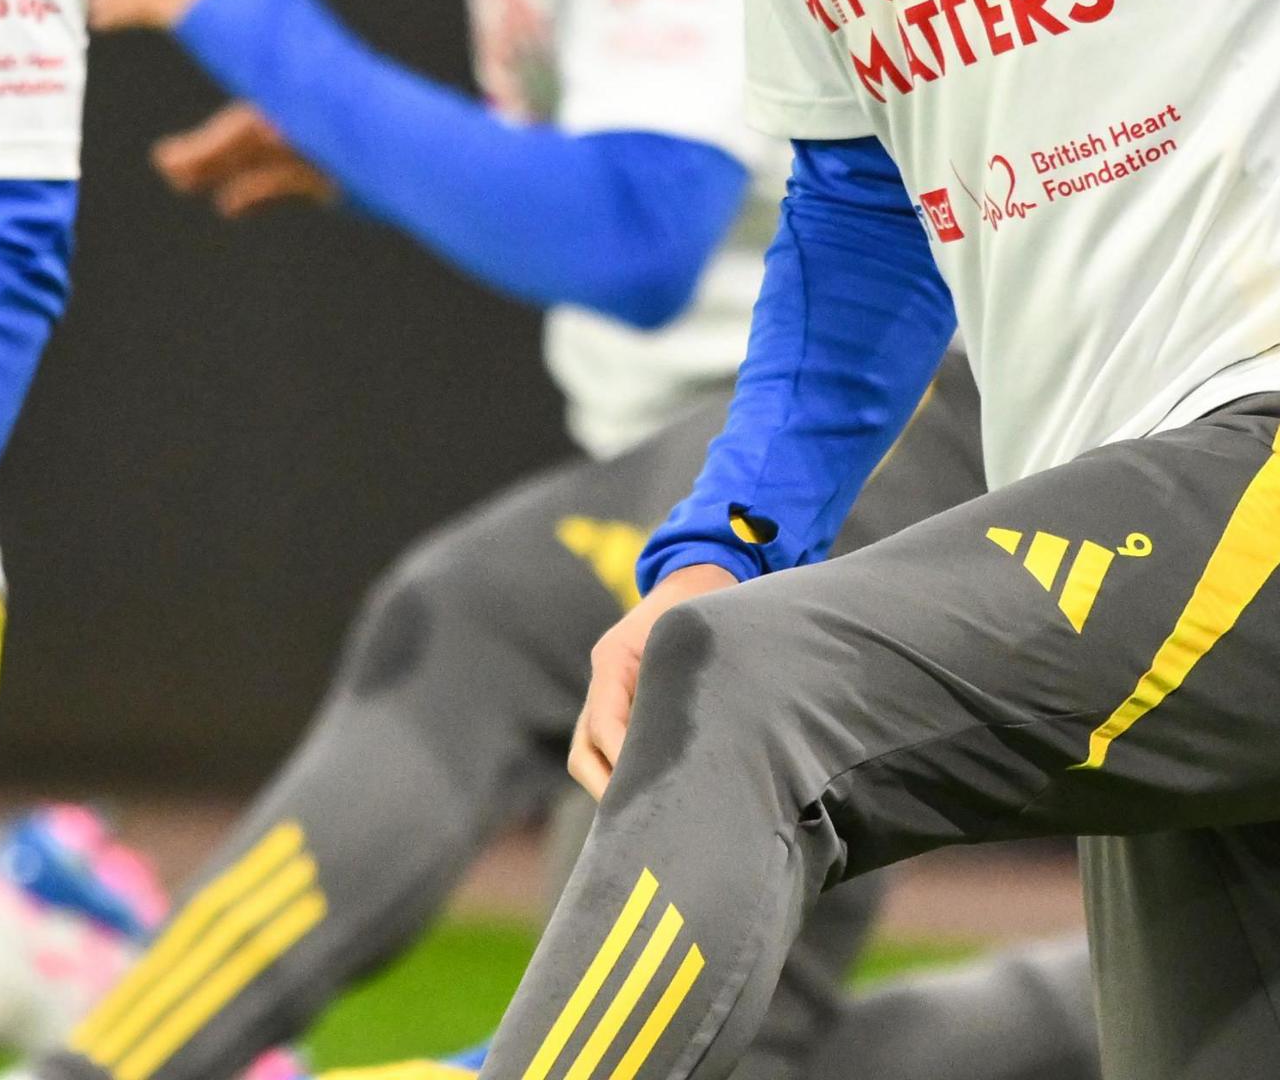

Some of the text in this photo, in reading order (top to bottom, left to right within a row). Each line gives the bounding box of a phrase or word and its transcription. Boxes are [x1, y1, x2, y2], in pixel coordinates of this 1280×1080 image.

[1031, 104, 1181, 174] British Heart
[1042, 138, 1177, 201] Foundation
